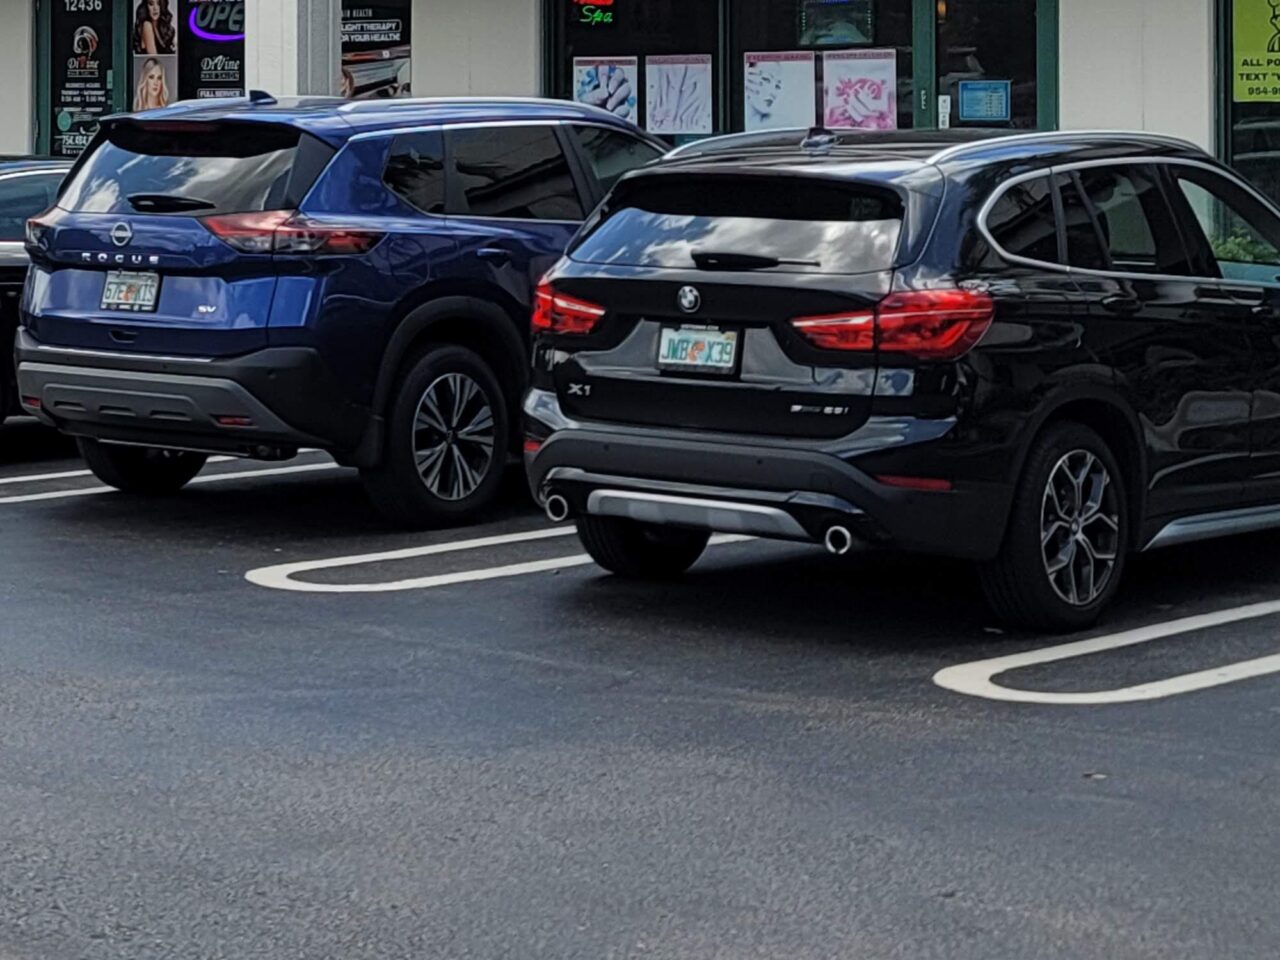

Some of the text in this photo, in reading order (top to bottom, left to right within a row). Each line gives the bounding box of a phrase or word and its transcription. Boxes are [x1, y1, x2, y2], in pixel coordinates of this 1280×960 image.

[196, 3, 245, 31] OPE
[580, 5, 613, 25] Spa
[1238, 72, 1267, 81] TEXT
[82, 252, 159, 264] ROGUE
[198, 305, 217, 313] SV
[568, 383, 591, 396] X1
